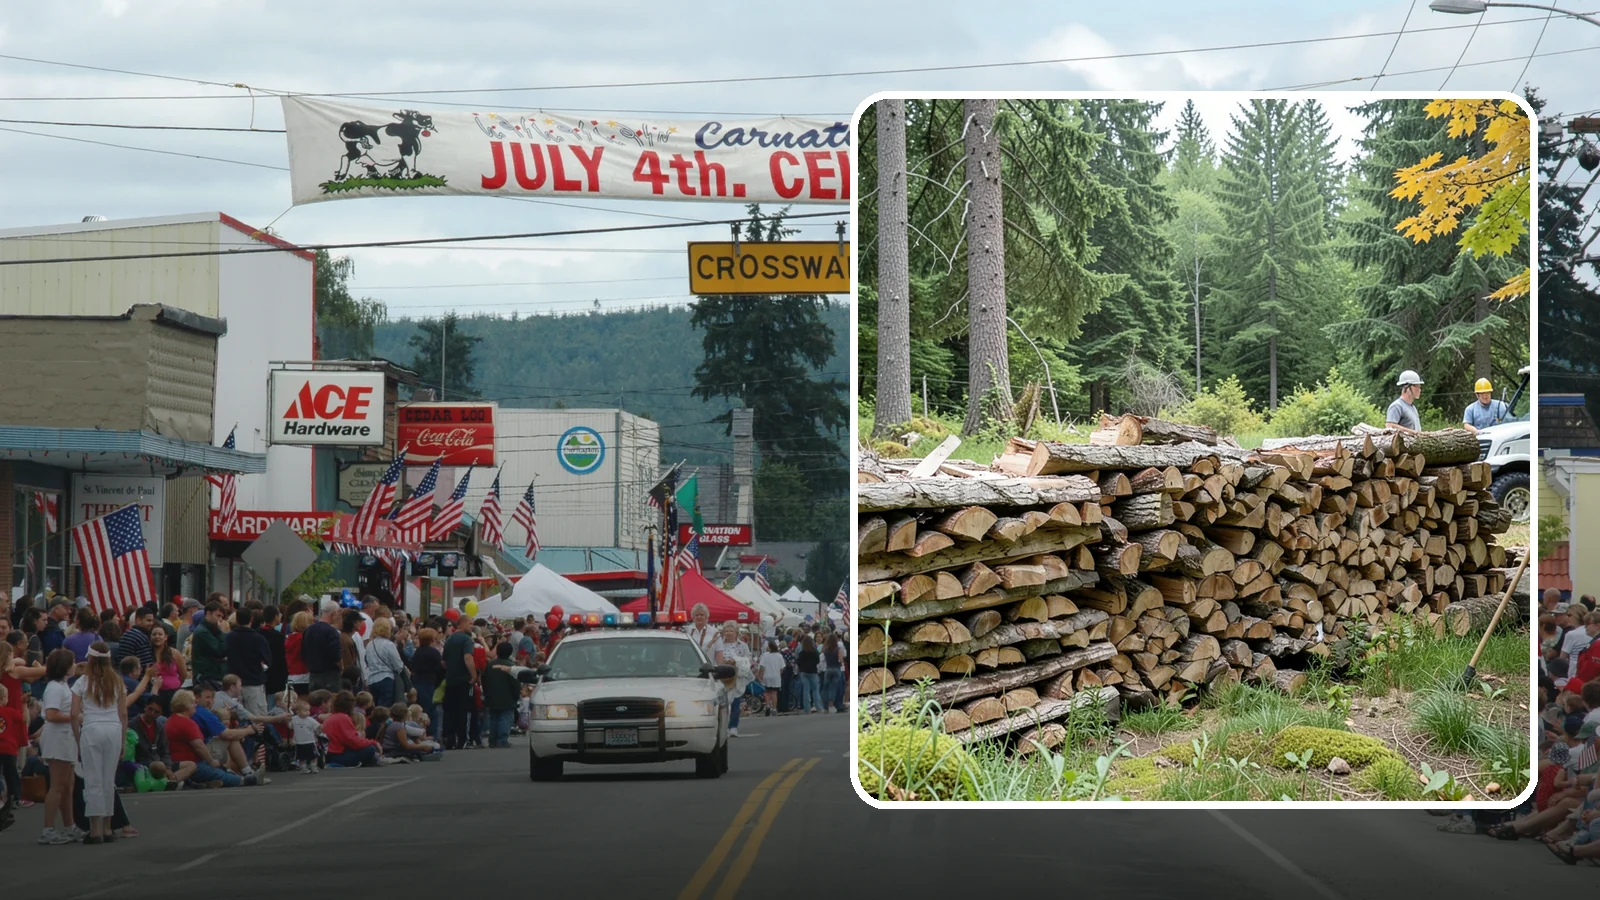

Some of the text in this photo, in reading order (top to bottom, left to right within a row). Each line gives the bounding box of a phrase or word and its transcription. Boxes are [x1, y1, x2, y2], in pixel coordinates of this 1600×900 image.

[481, 141, 605, 192] JULY
[632, 150, 746, 198] 4th.
[697, 254, 850, 279] CROSSWA
[282, 380, 373, 420] ACE
[405, 409, 453, 421] CEDAR
[283, 421, 370, 436] Hardware
[416, 428, 477, 447] Coca-Cola
[95, 485, 124, 495] Vincent
[126, 486, 135, 495] de
[137, 486, 155, 495] Paul
[688, 526, 741, 535] CRNATION
[699, 535, 730, 543] GLASS
